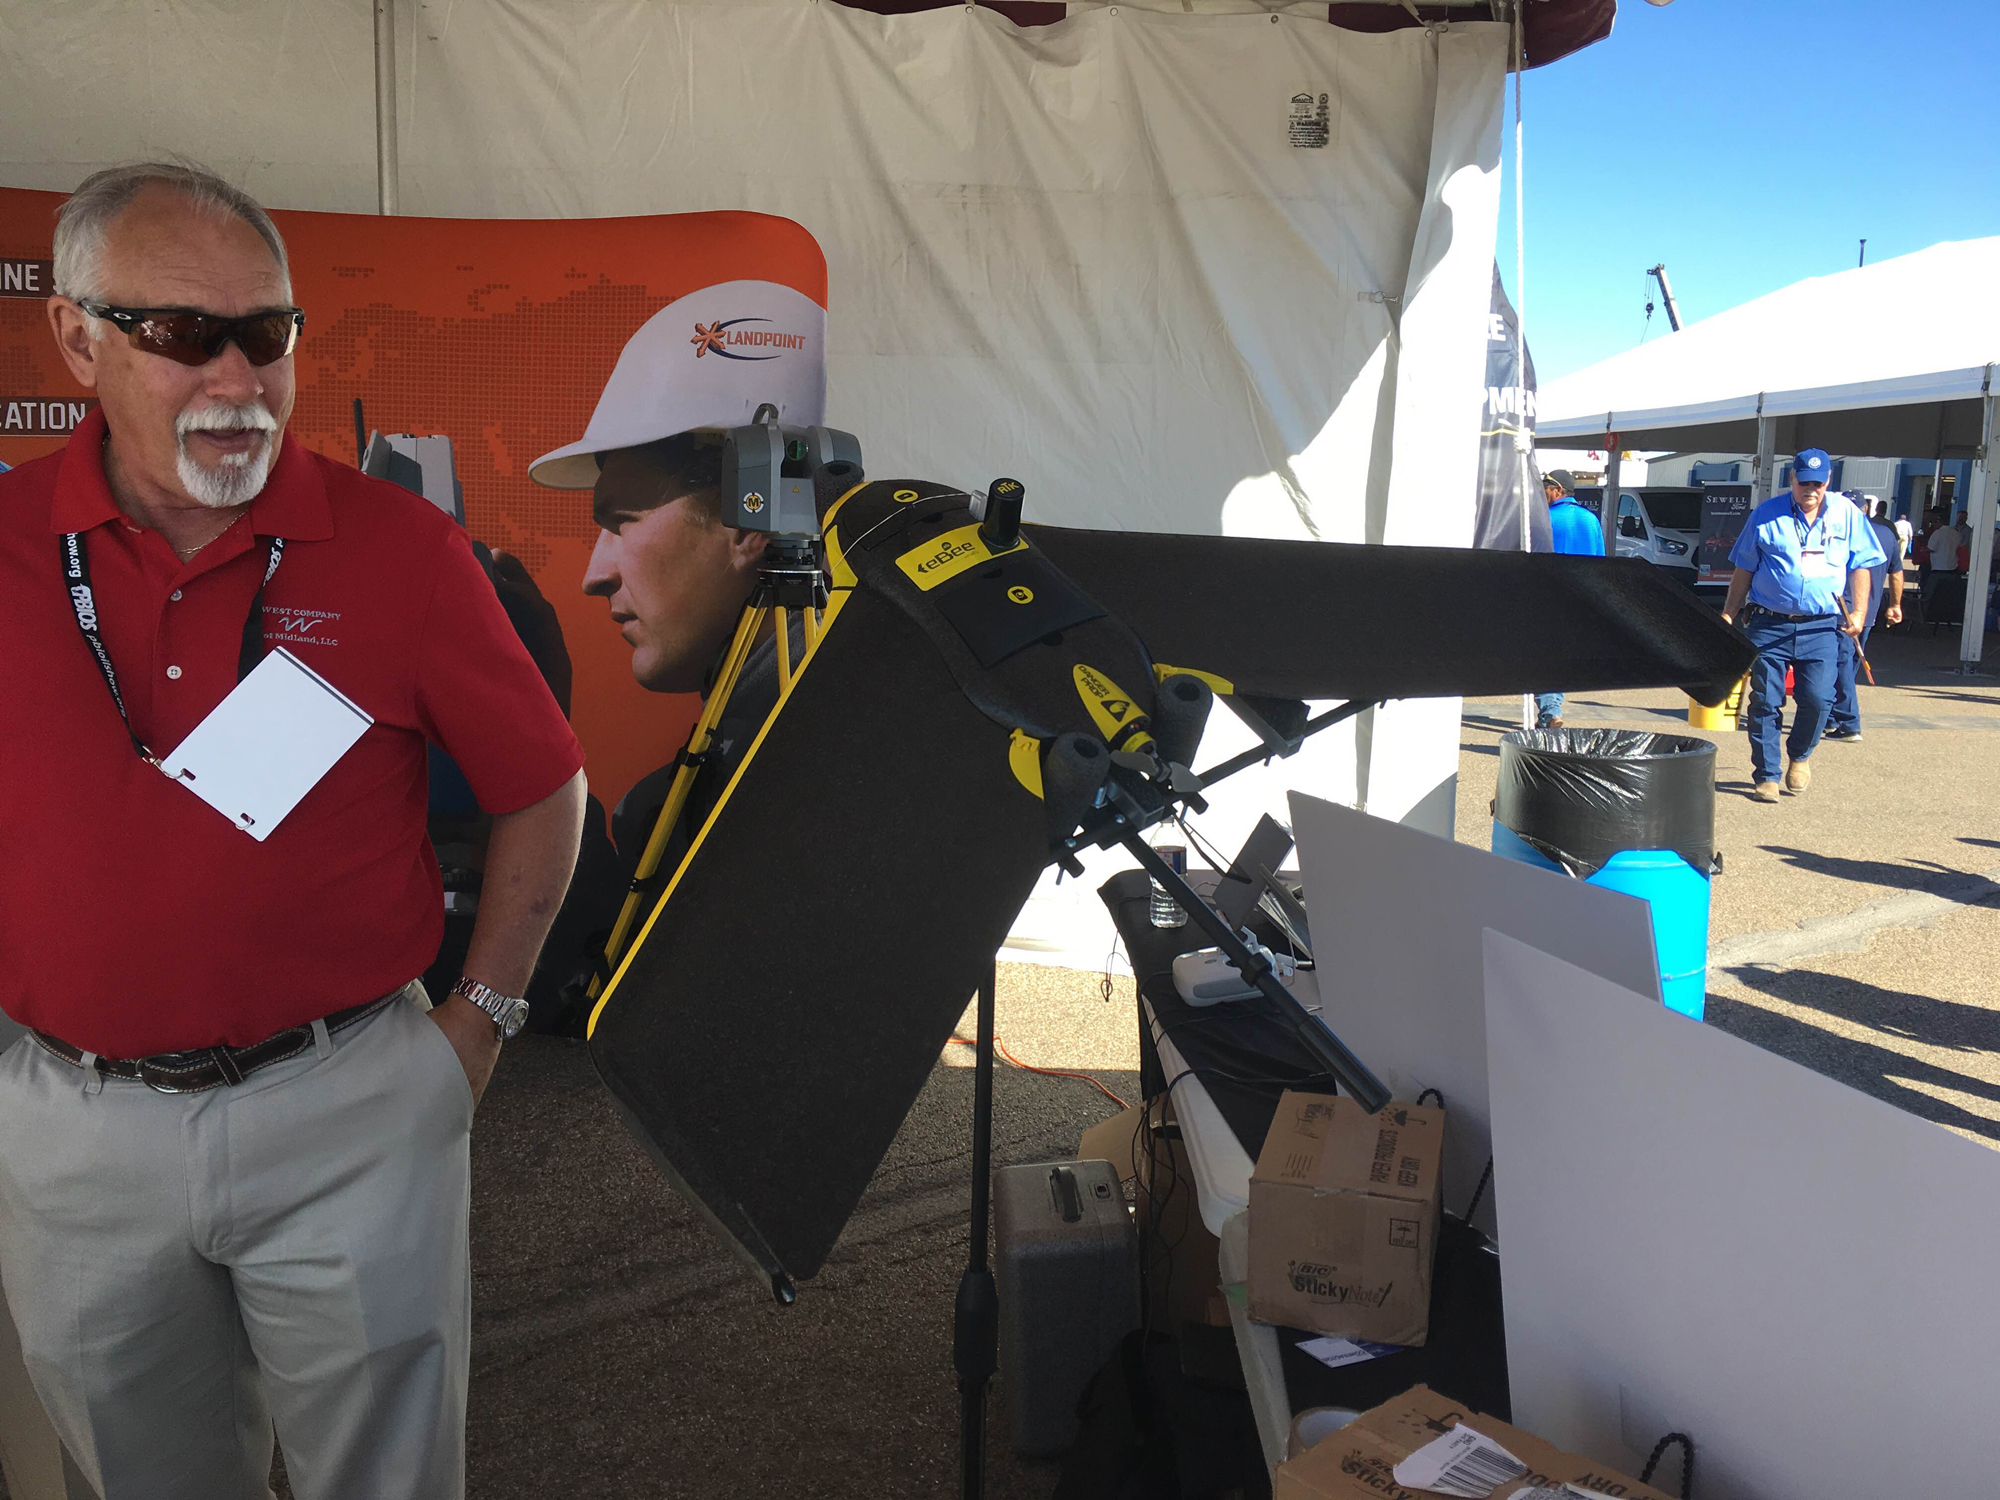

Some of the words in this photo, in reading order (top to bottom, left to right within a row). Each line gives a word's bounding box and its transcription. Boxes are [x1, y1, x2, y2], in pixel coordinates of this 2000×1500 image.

[0, 263, 40, 291] NE
[726, 330, 806, 350] LANDPOINT
[0, 401, 86, 430] ATION
[997, 481, 1020, 495] RTK
[1706, 495, 1747, 503] SEWELL
[925, 542, 976, 570] eBee
[262, 606, 292, 616] WEST
[293, 609, 341, 620] COMPANY
[320, 637, 339, 646] LLC
[1078, 665, 1110, 696] DANGER
[1080, 677, 1104, 699] PROP
[1301, 1265, 1329, 1276] BIC
[1574, 1472, 1629, 1496] DRY
